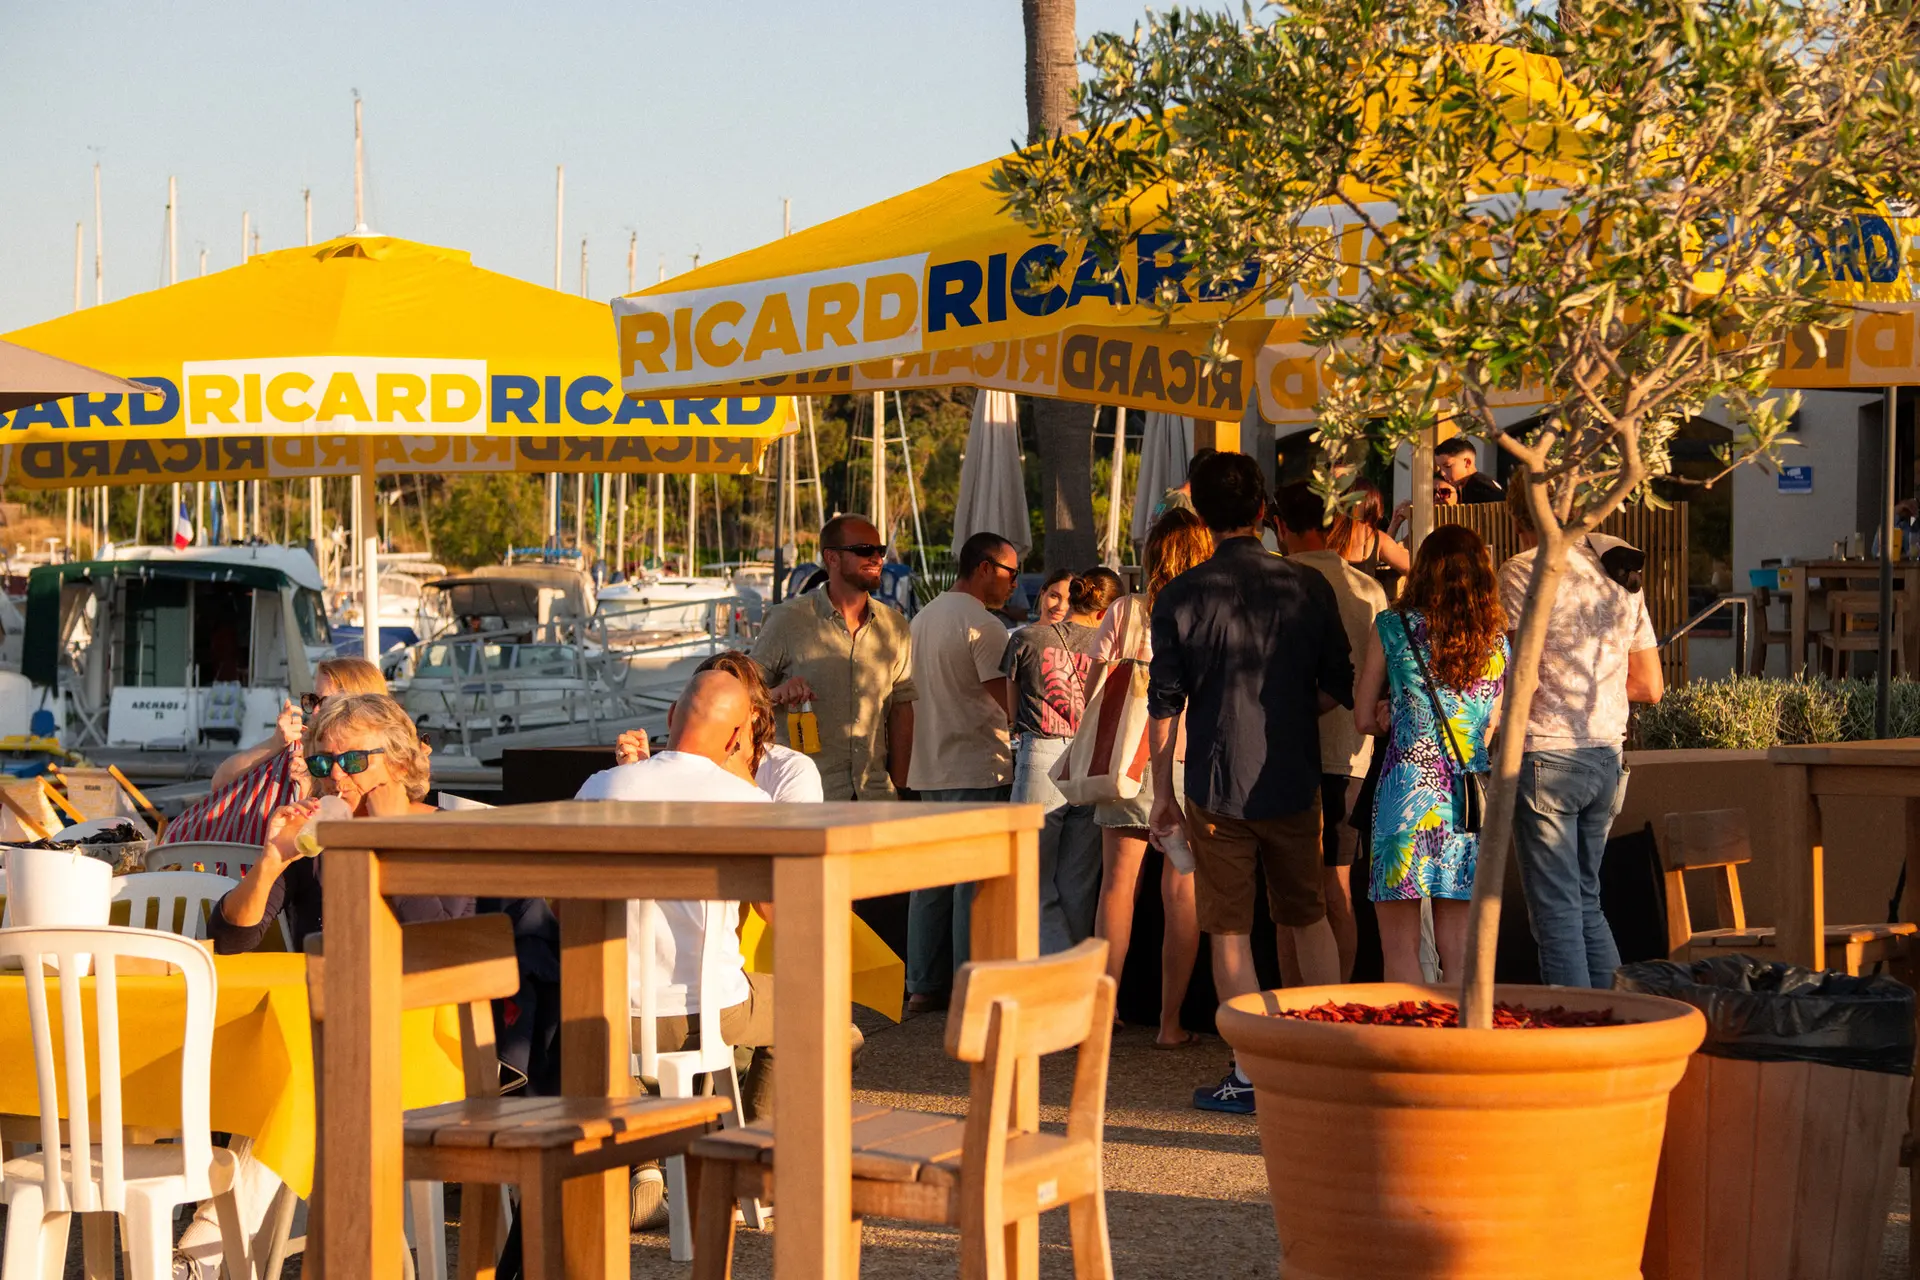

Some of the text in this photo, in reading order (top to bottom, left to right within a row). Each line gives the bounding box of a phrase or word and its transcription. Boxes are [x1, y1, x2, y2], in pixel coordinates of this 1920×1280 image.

[620, 273, 918, 377] RICARD
[0, 371, 776, 430] ARD RICARD RICARD
